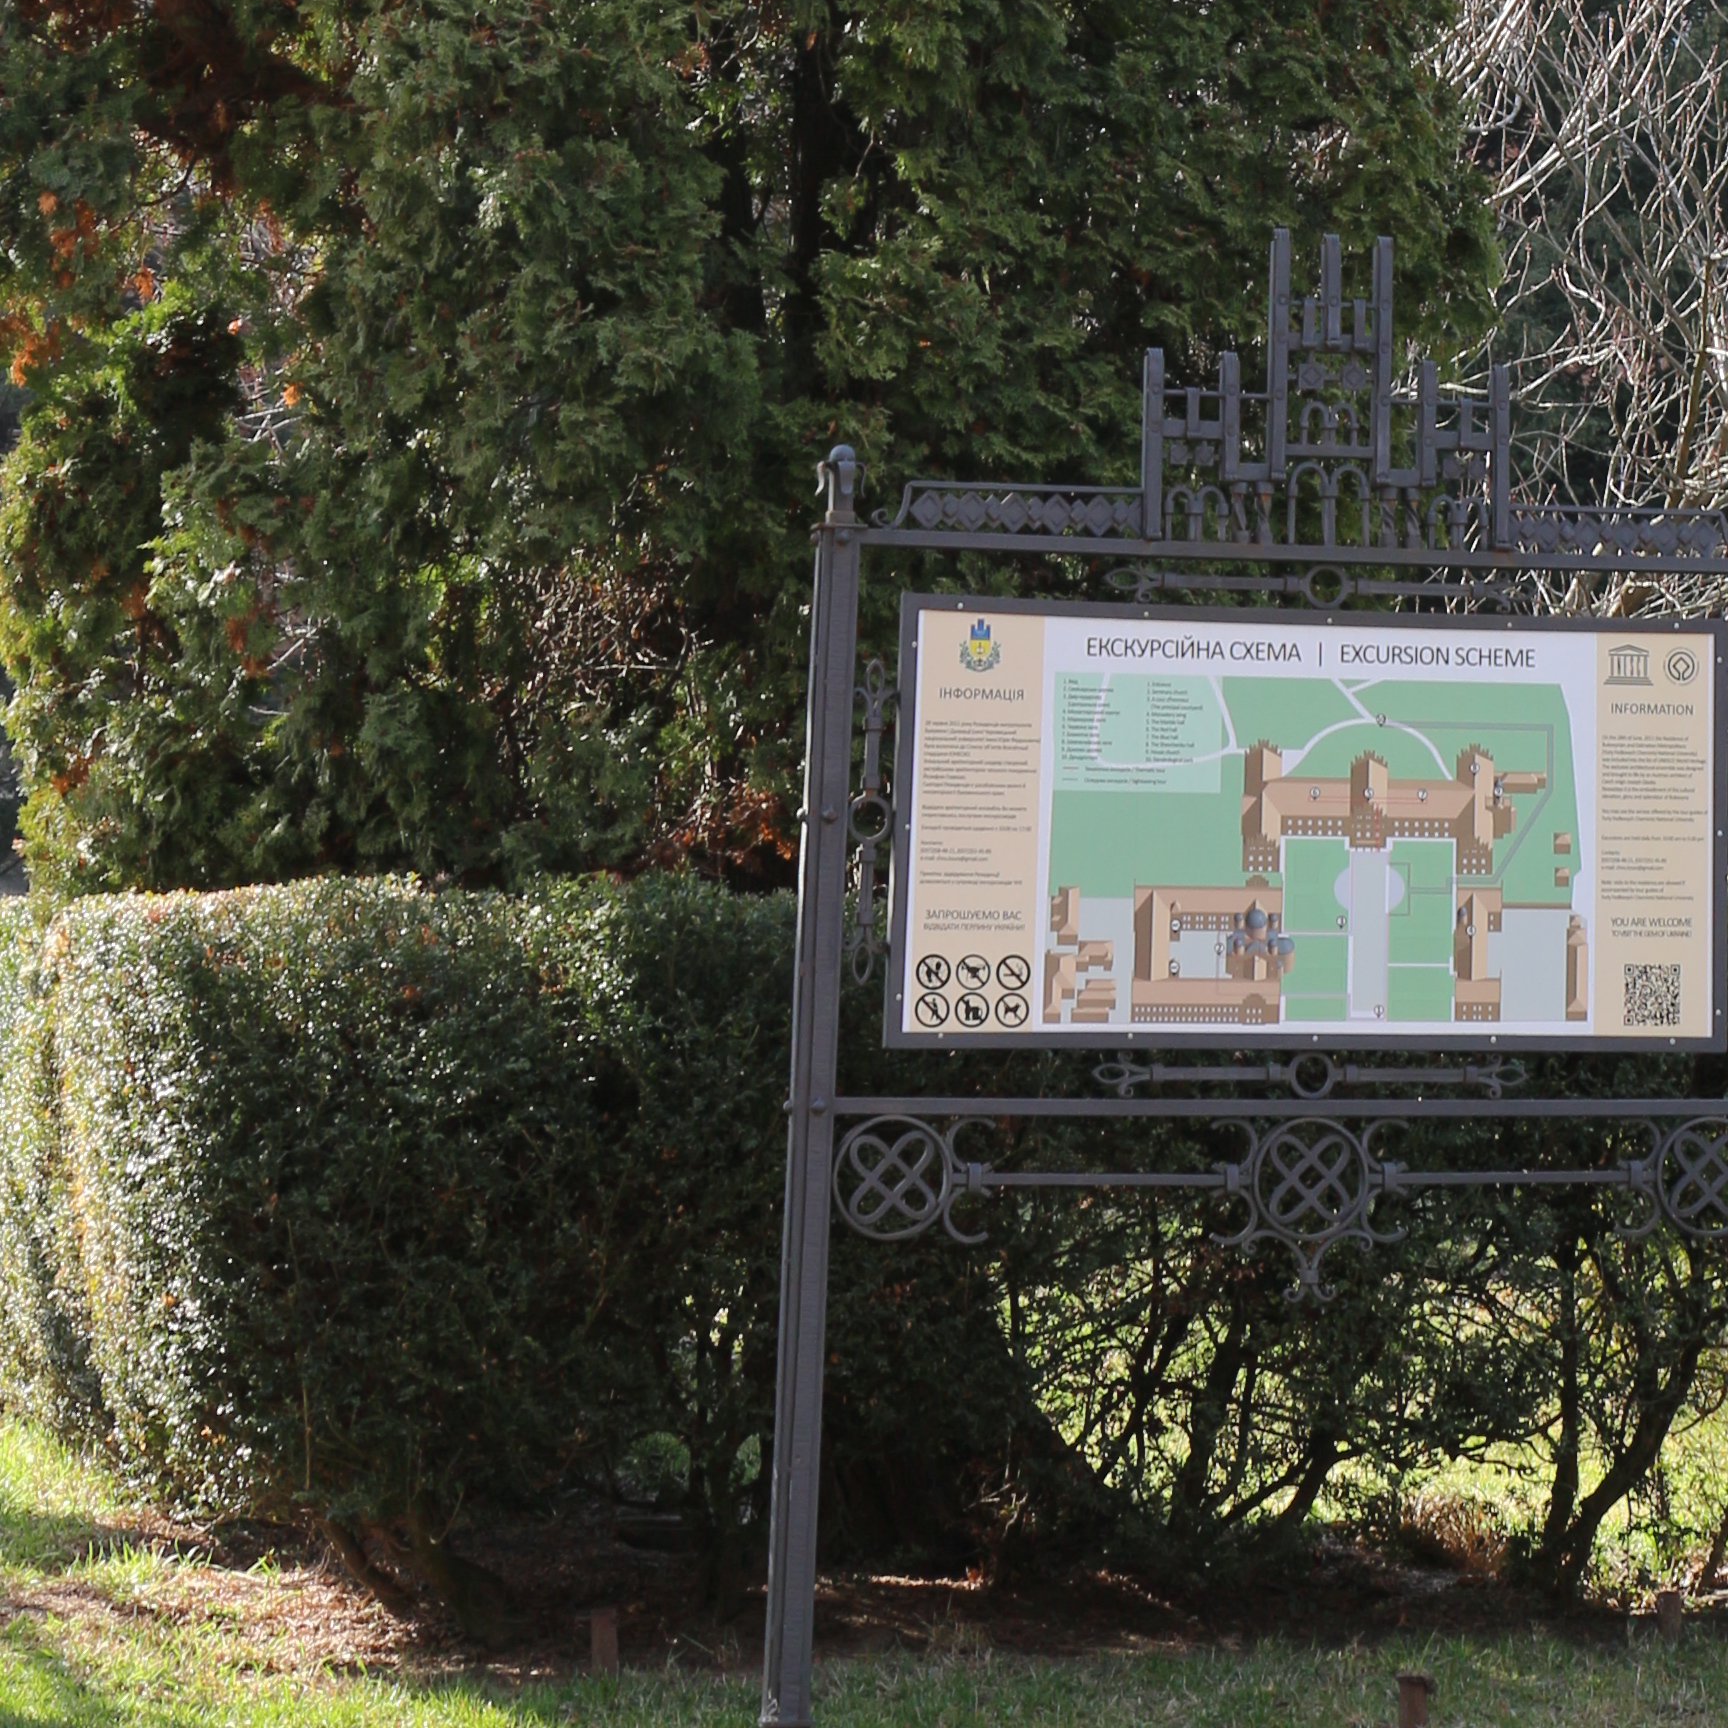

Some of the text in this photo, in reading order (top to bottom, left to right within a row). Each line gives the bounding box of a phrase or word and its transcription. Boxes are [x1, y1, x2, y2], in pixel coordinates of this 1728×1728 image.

[1086, 635, 1302, 662] ЕКСКУРСІЙНА СХЕМА
[1340, 644, 1535, 668] EXCURSION SCHEME
[939, 687, 1025, 702] ІНФОРМАЦІЯ
[1611, 703, 1694, 715] INFORMATION
[925, 909, 1022, 921] ЗАПРОШУЄМО ВАС
[1611, 917, 1692, 928] YOU ARE WELCOME
